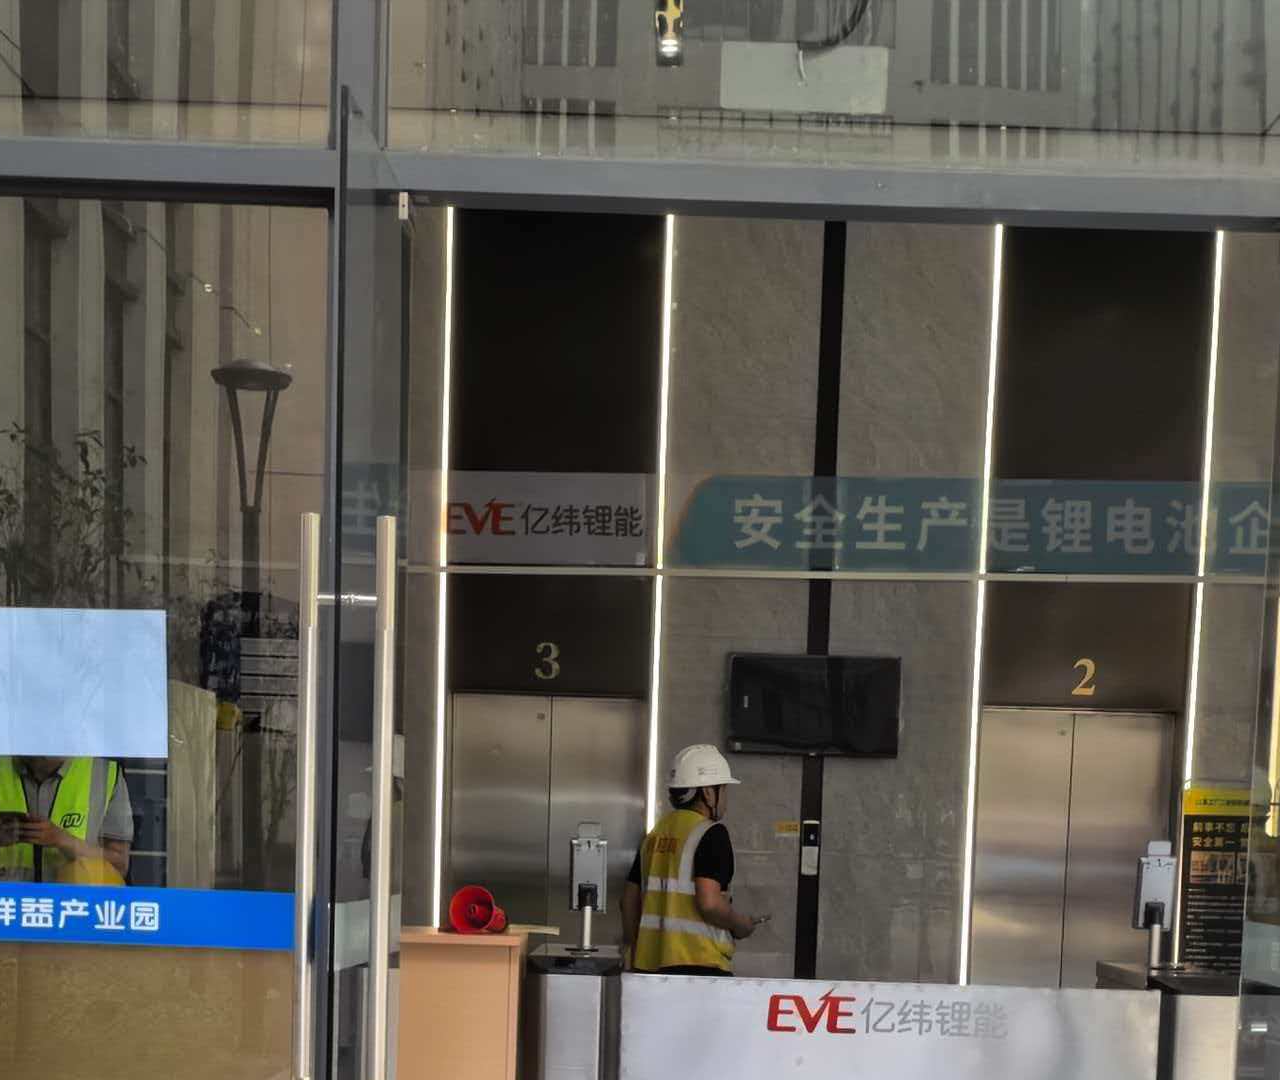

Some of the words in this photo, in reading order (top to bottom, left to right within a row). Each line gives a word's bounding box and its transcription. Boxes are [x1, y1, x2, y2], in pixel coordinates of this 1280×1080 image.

[445, 496, 516, 536] EVE
[520, 503, 643, 537] 亿纬锂能
[534, 642, 560, 680] 3
[1071, 658, 1096, 696] 2
[766, 988, 856, 1034] EVE
[860, 997, 1008, 1039] 亿纬锂能
